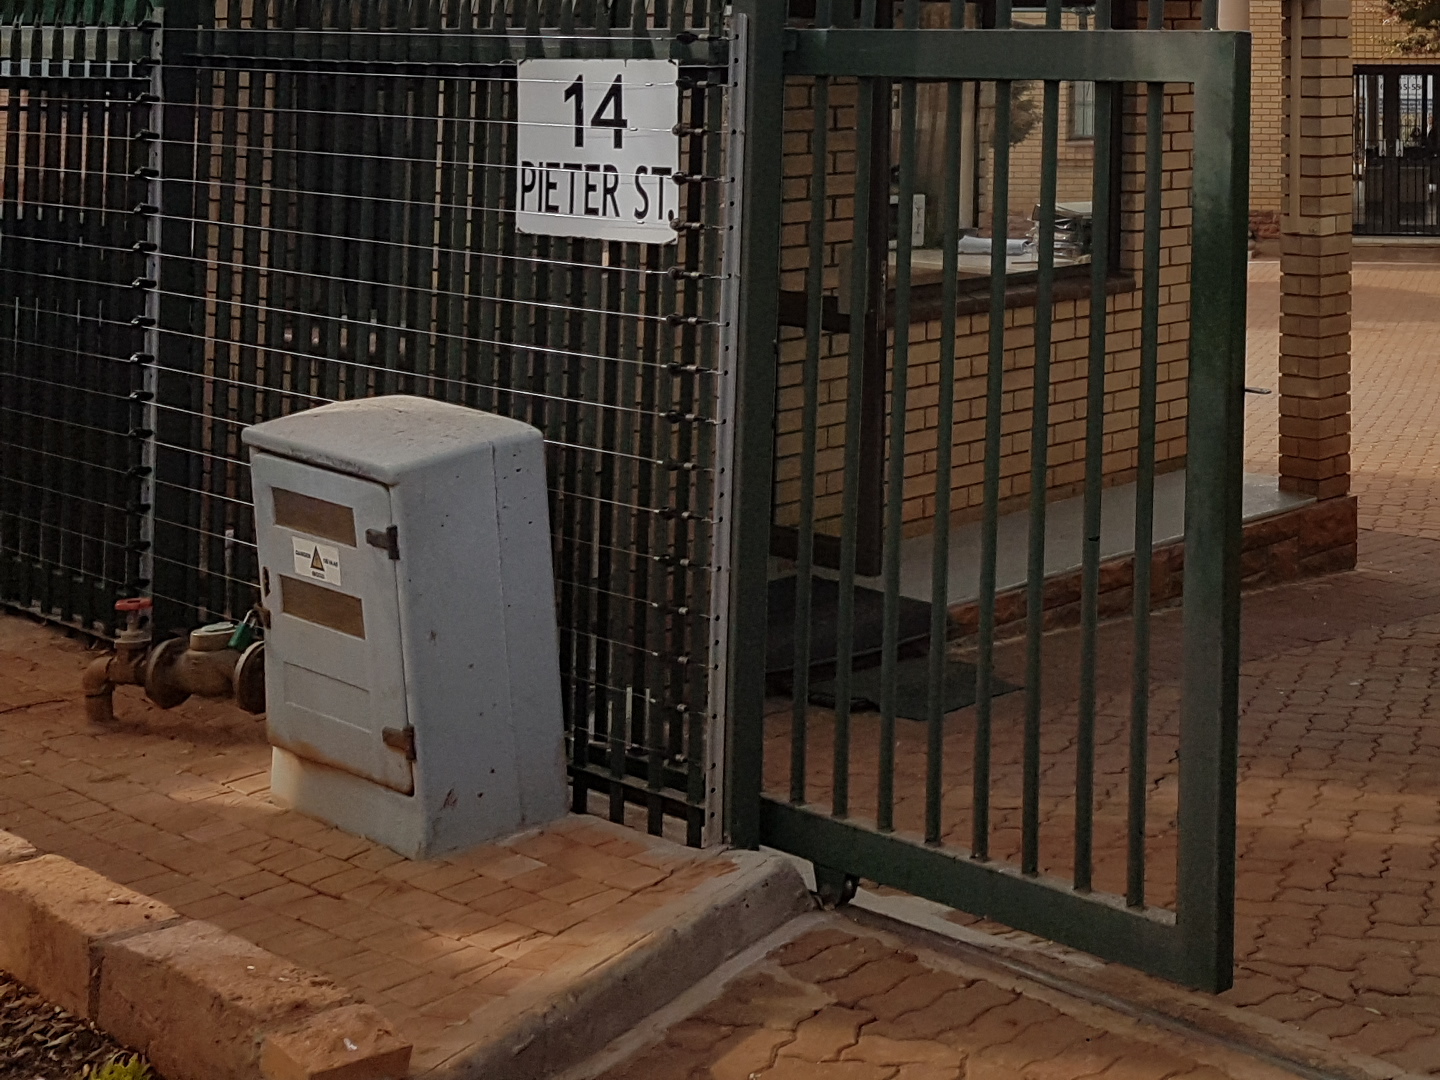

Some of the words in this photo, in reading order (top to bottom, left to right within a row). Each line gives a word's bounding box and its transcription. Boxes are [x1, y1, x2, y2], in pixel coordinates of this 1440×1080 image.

[564, 74, 627, 149] 14
[521, 161, 620, 218] PIETER
[634, 164, 675, 221] ST.
